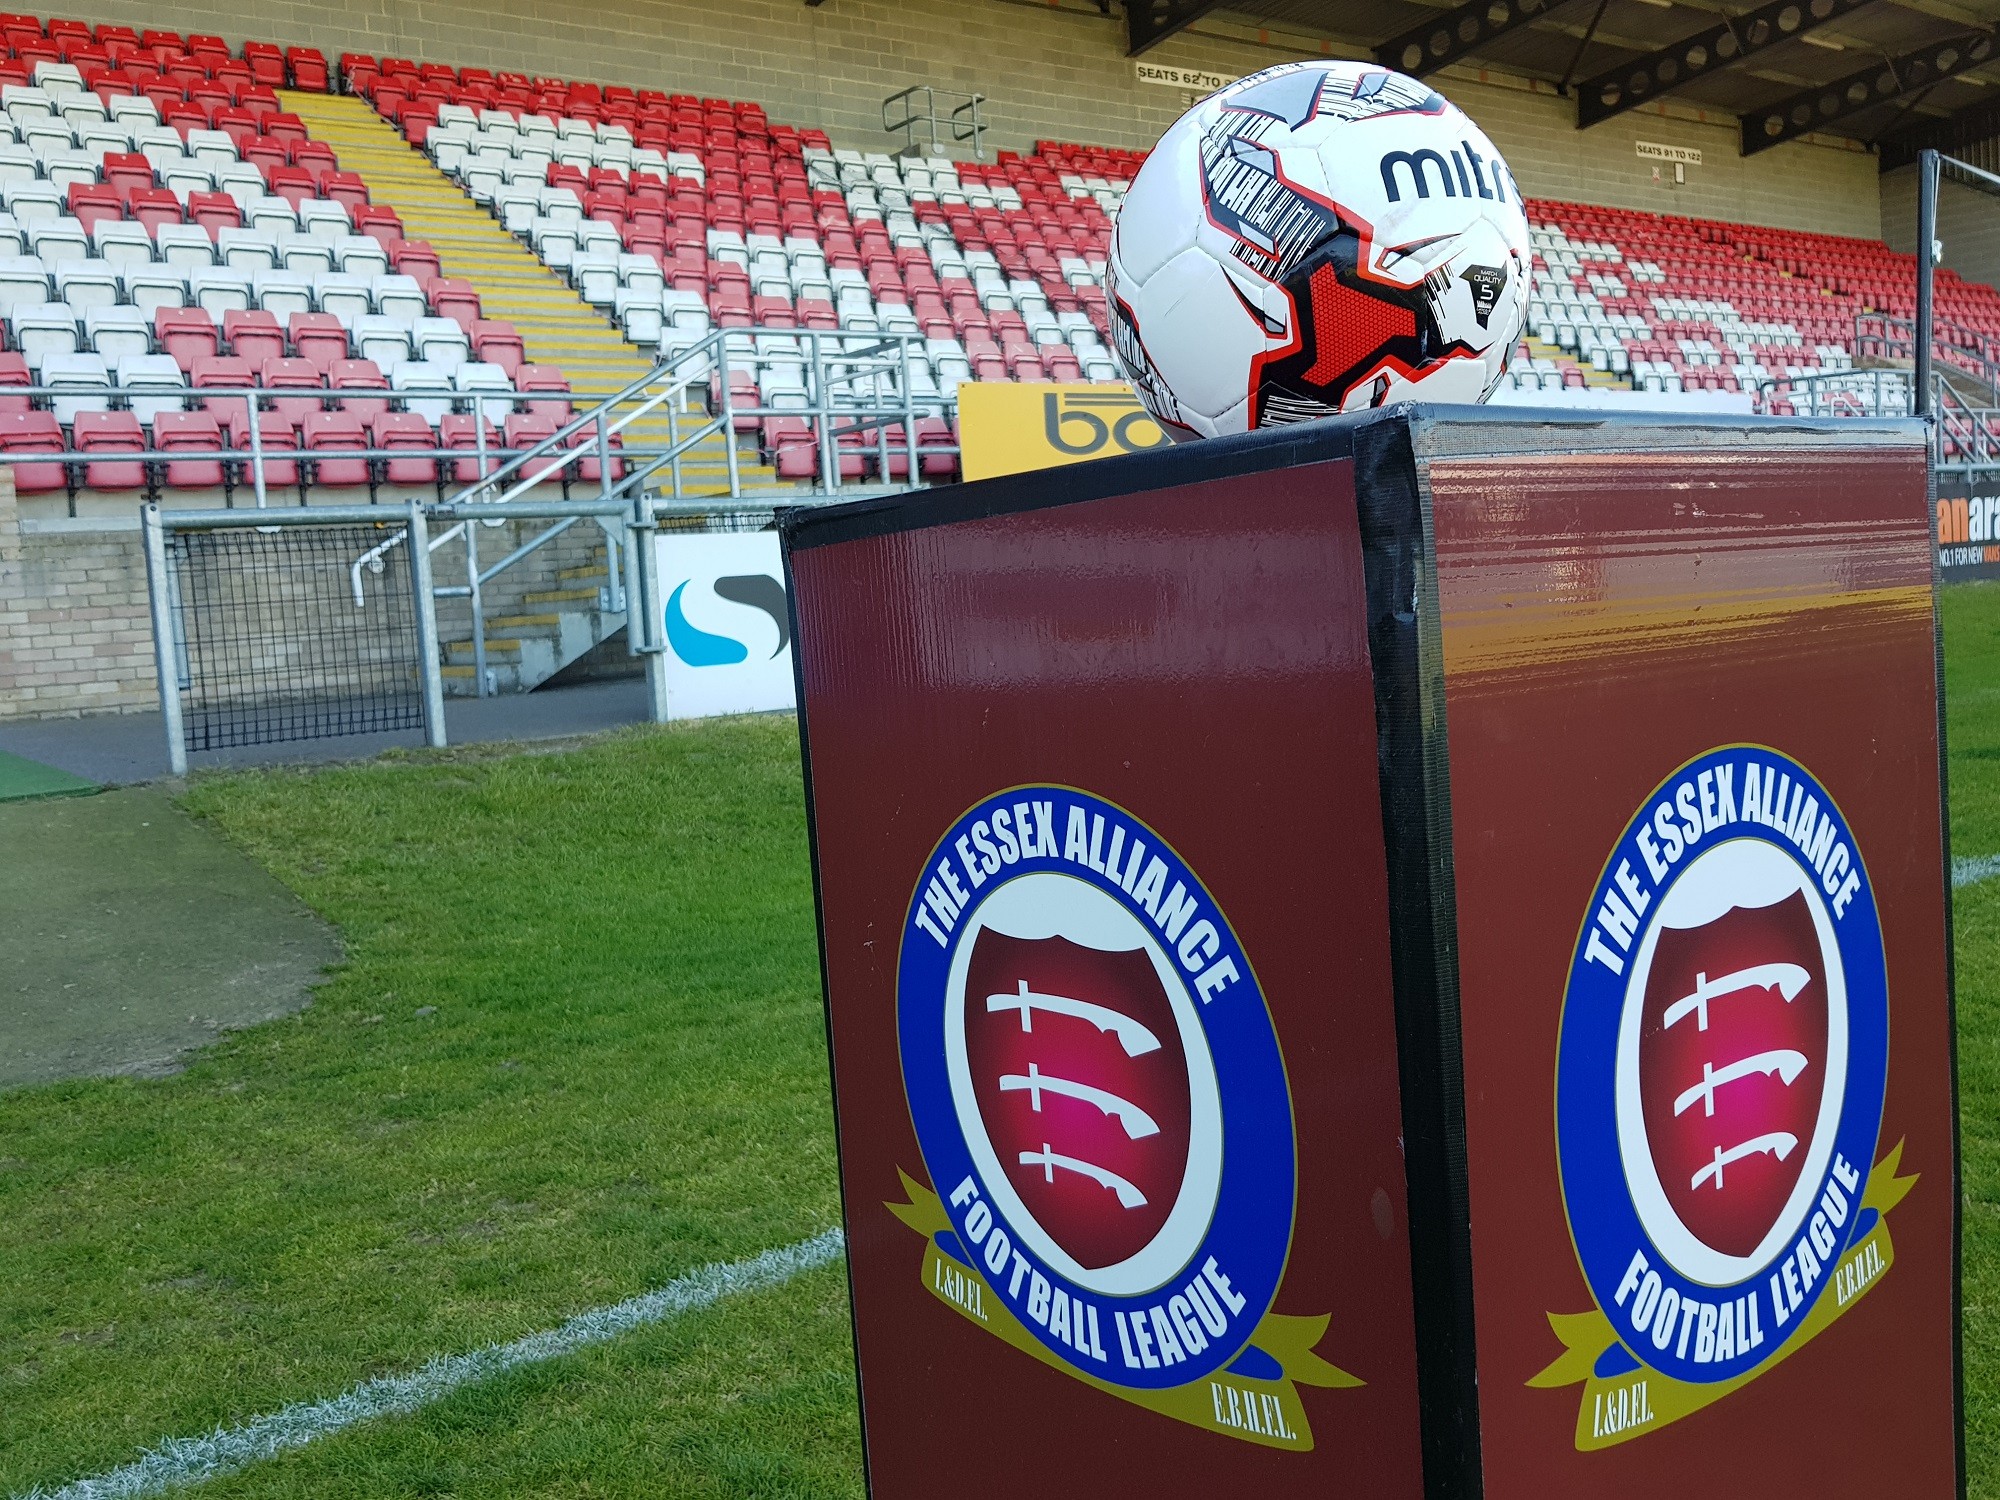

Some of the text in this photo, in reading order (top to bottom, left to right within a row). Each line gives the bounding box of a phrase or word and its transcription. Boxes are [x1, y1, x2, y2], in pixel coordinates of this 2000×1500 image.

[1137, 66, 1179, 82] SEATS
[1183, 73, 1199, 85] 62
[1205, 76, 1220, 88] TO
[1637, 144, 1662, 156] SEATS
[1674, 150, 1686, 159] TO
[1473, 274, 1502, 285] QUALITY
[1480, 269, 1498, 277] MATCH
[1480, 284, 1494, 300] 5
[1955, 547, 1968, 566] FOR
[1968, 545, 1983, 565] NEW
[1584, 762, 1861, 975] THE ESSEX ALLIANCE
[914, 801, 1240, 1005] THE ESSEX ALLIANCE
[1613, 1152, 1860, 1363] FOOTBALL LEAGUE
[949, 1174, 1247, 1369] FOOTBALL LEAGUE
